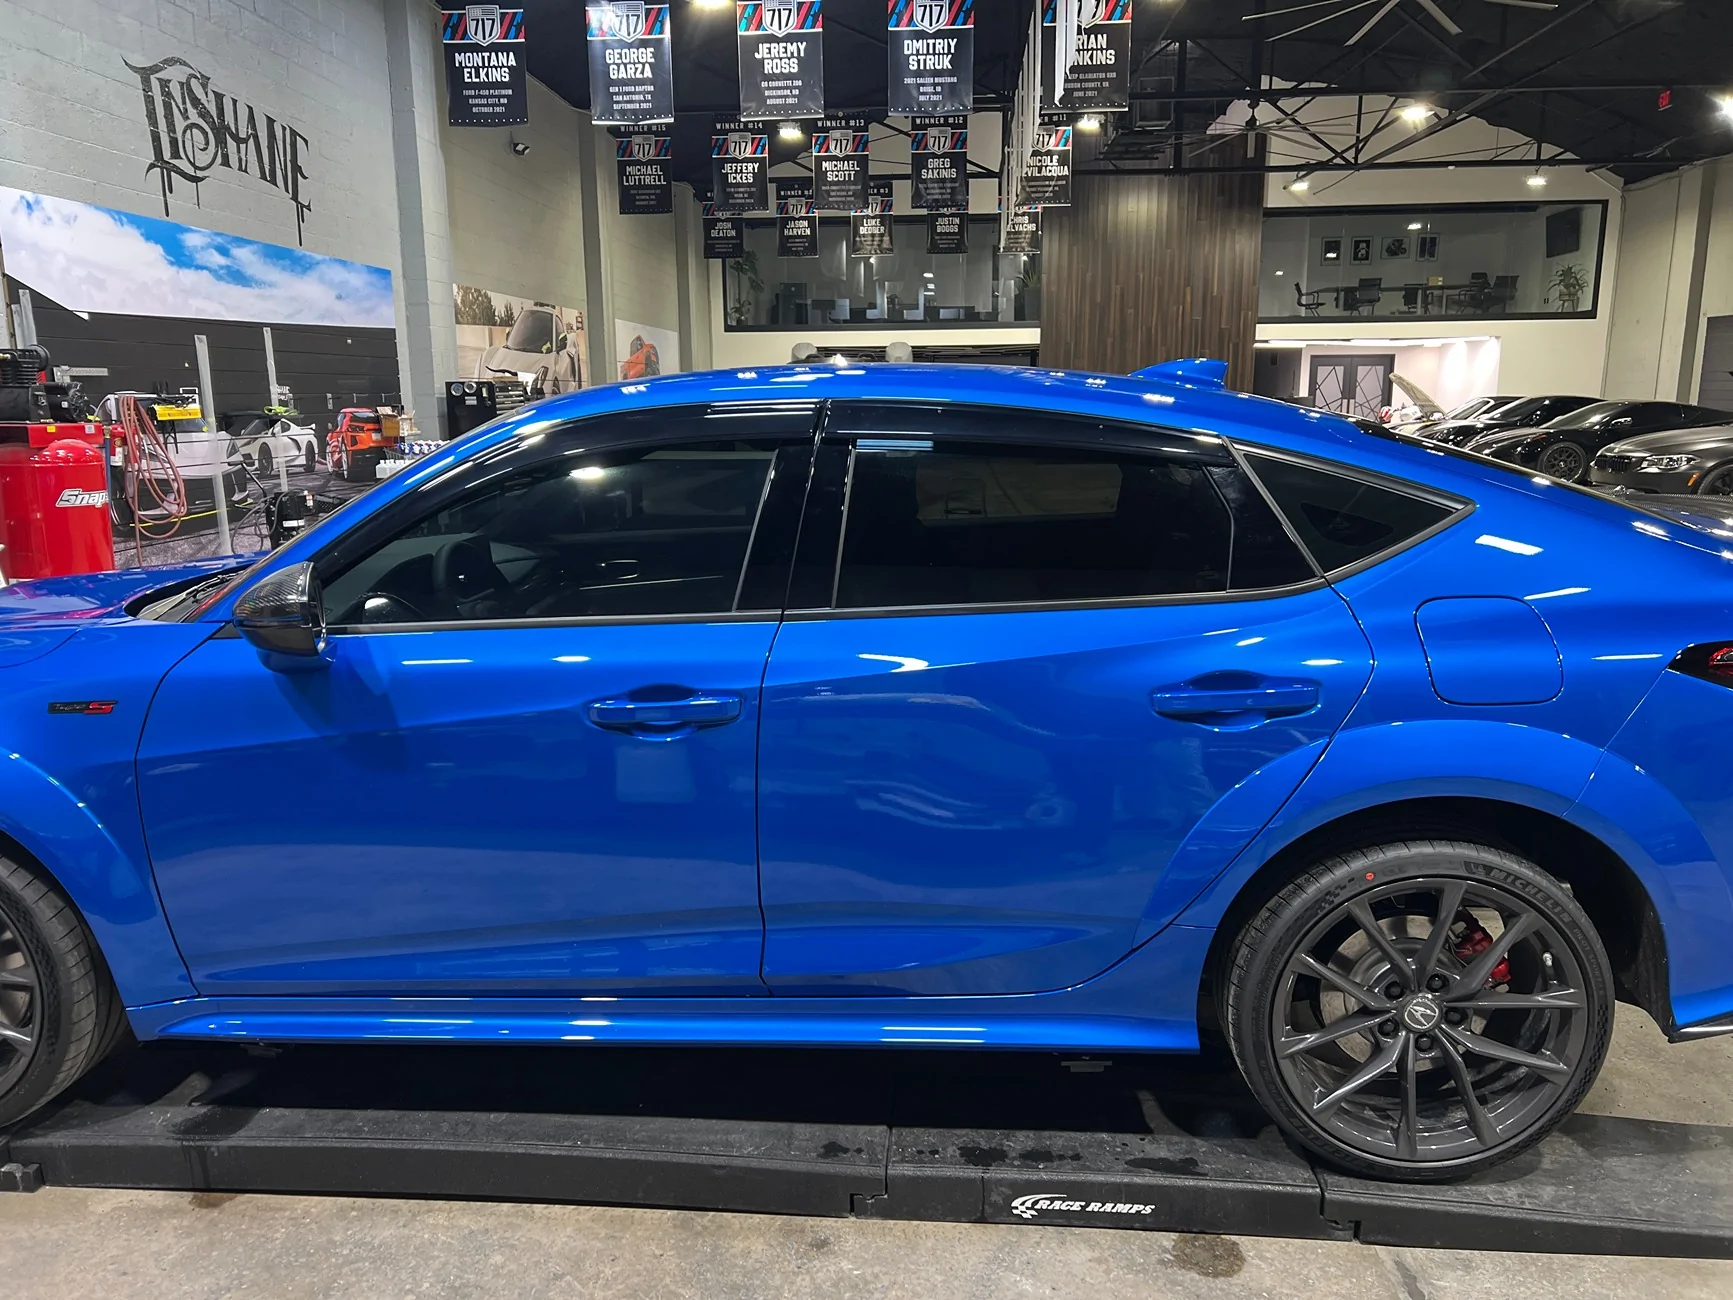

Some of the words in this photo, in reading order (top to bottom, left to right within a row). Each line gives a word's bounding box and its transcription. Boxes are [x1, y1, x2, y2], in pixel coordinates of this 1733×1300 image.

[767, 8, 793, 30] 717
[918, 4, 944, 27] 717
[471, 18, 496, 40] 717
[615, 14, 641, 38] 717
[904, 38, 957, 55] DMITRIY
[1076, 34, 1107, 49] RIAN
[605, 47, 655, 64] GEORGE
[754, 42, 806, 59] JEREMY
[1073, 49, 1115, 65] NKINS
[454, 52, 516, 67] MONTANA
[764, 58, 798, 74] ROSS
[908, 54, 952, 70] STRUK
[463, 68, 510, 82] ELKINS
[609, 63, 652, 79] GARZA
[915, 117, 944, 125] WINNER
[731, 141, 748, 155] 717
[832, 138, 850, 153] 717
[931, 135, 948, 151] 717
[1036, 134, 1052, 148] 717
[635, 143, 652, 158] 717
[721, 162, 759, 173] JEFFERY
[821, 160, 860, 171] MICHAEL
[927, 158, 951, 168] GREG
[1027, 155, 1059, 166] NICOLE
[626, 165, 663, 176] MICHAEL
[827, 171, 856, 181] SCOTT
[921, 168, 957, 179] SAKINIS
[1023, 165, 1069, 177] VILACQUA
[623, 175, 667, 185] LUTTRELL
[727, 173, 754, 183] ICKES
[714, 222, 732, 230] JOSH
[786, 220, 808, 228] JASON
[863, 218, 881, 227] LUKE
[935, 217, 960, 225] JUSTIN
[710, 229, 736, 237] DEATON
[783, 227, 811, 236] HARVEN
[56, 489, 109, 508] Snap
[1490, 869, 1574, 923] MICHELIN
[1034, 1199, 1086, 1211] RACE
[1086, 1201, 1156, 1214] RAMPS
